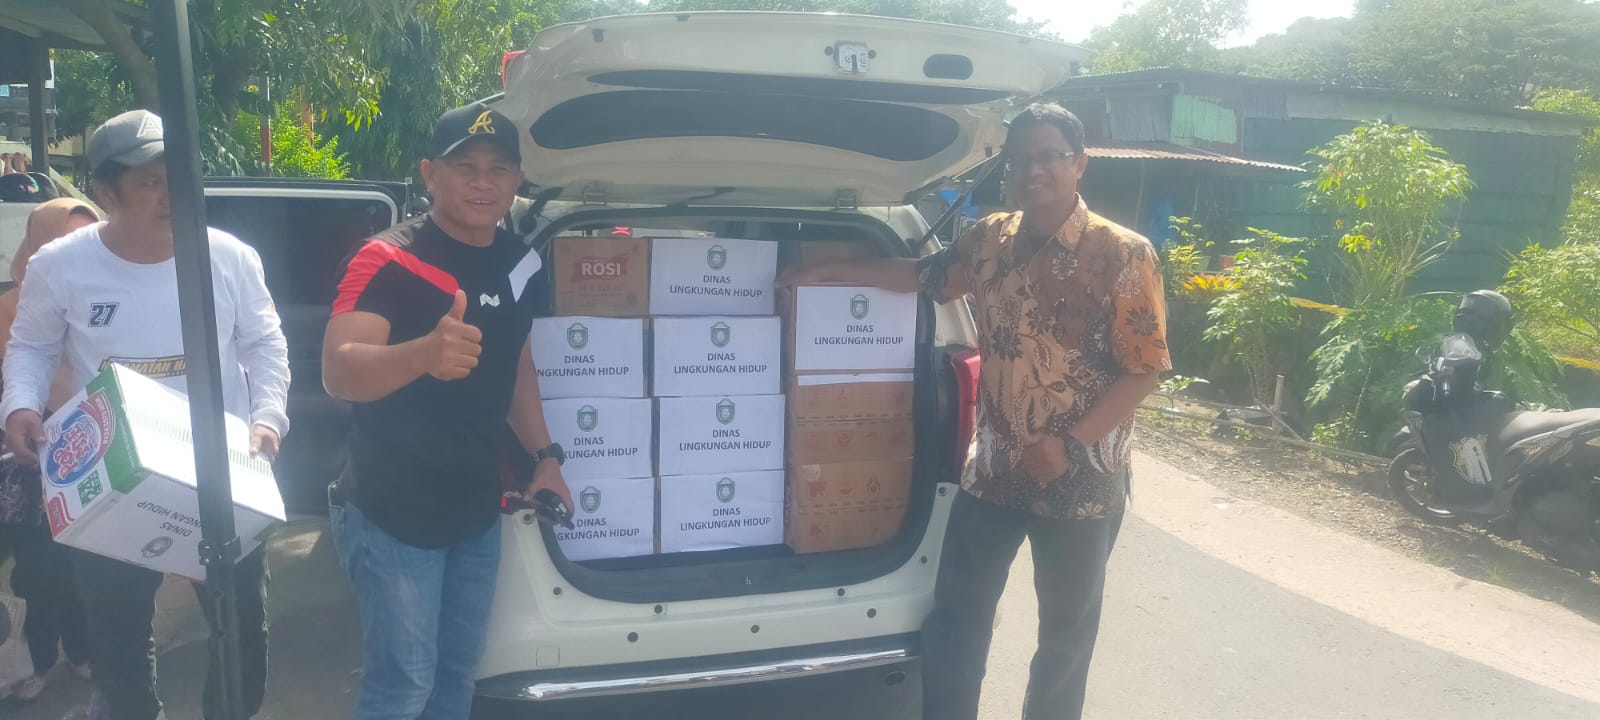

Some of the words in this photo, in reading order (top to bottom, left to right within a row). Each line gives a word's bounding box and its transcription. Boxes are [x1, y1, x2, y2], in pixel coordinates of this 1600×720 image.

[581, 262, 621, 276] ROSI
[703, 274, 731, 284] DINAS
[669, 285, 731, 297] LINGKUNGAN
[733, 288, 763, 298] HIDUP
[88, 302, 120, 327] 27
[846, 324, 874, 333] DINAS
[814, 336, 874, 345] LINGKUNGAN
[876, 336, 904, 345] HIDUP
[564, 355, 595, 364] DINAS
[707, 352, 736, 361] DINAS
[536, 367, 596, 377] NGKUNGAN
[598, 366, 630, 376] HIDUP
[673, 365, 736, 374] LINGKUNGAN
[738, 364, 767, 374] HIDUP
[712, 429, 740, 438] DINAS
[574, 437, 605, 446] DINAS
[679, 441, 741, 451] LINGKUNGAN
[742, 440, 772, 450] HIDUP
[563, 449, 605, 460] KUNGAN
[607, 447, 639, 457] HIDUP
[137, 501, 171, 516] HIDUP
[712, 507, 741, 516] DINAS
[576, 517, 607, 528] DINAS
[680, 519, 741, 531] LINGKUNGAN
[743, 517, 771, 527] HIDUP
[160, 521, 193, 537] DINAS
[557, 530, 607, 541] GKUNGAN
[609, 528, 640, 538] HIDUP
